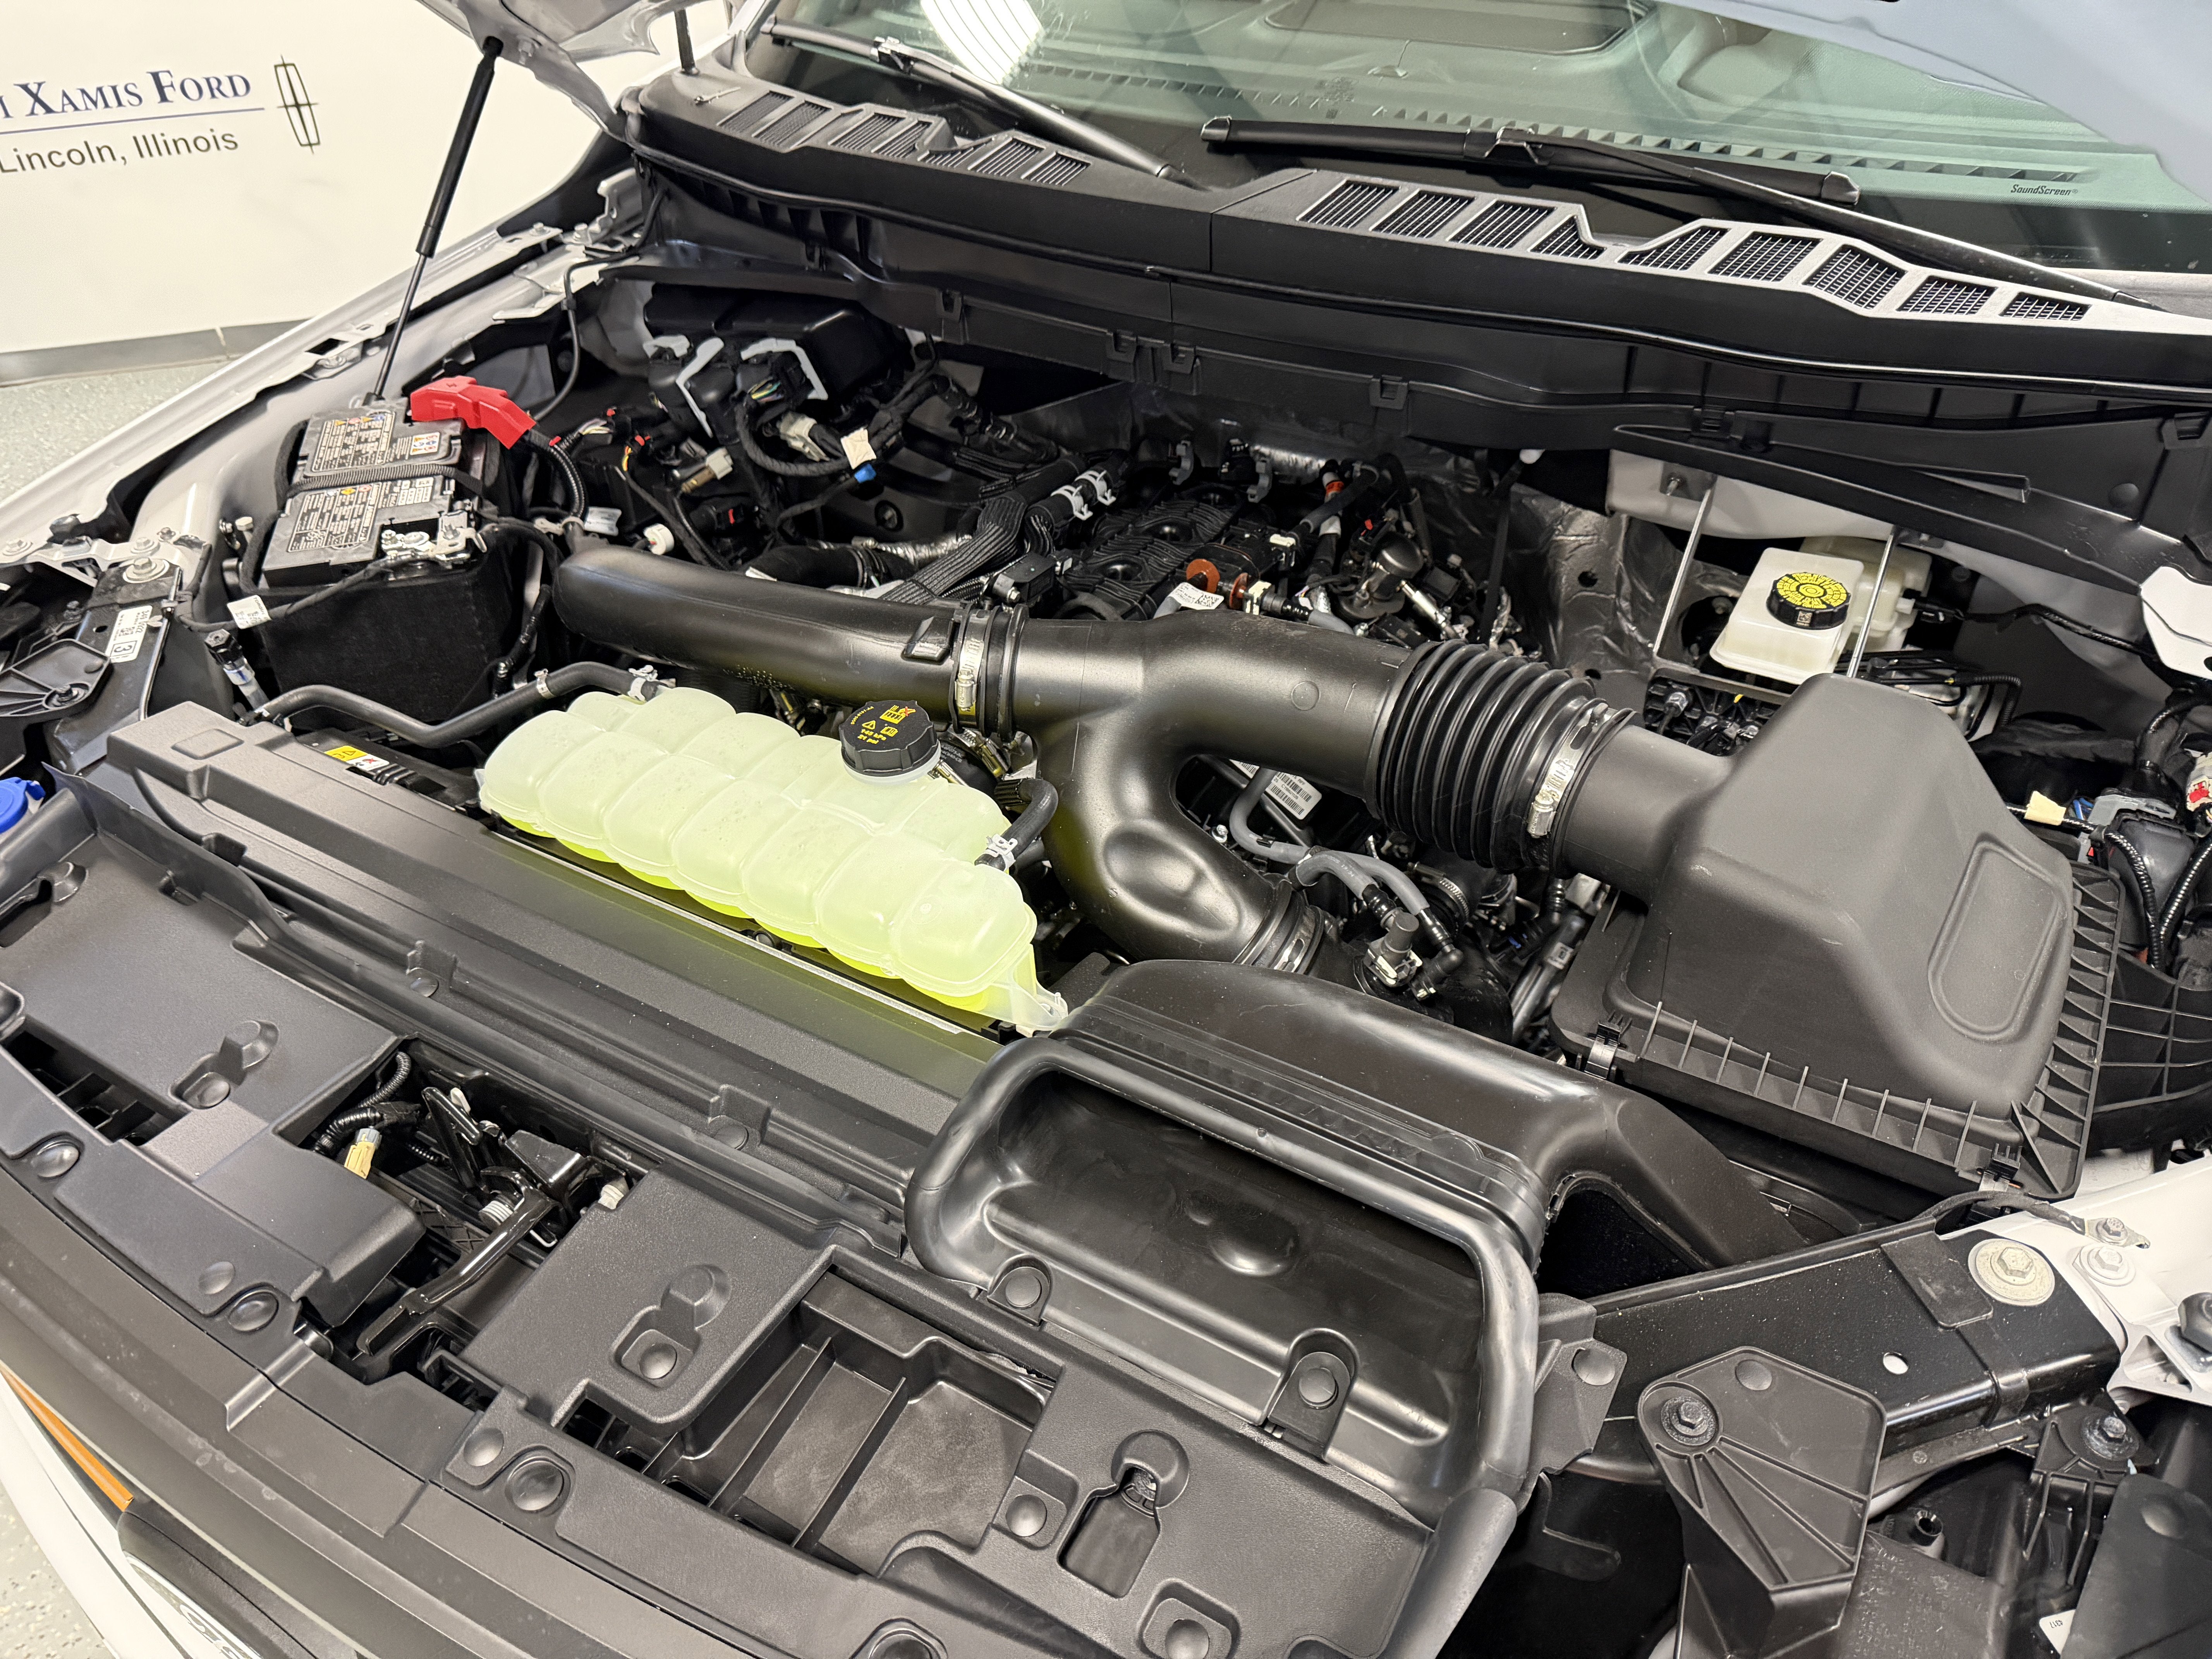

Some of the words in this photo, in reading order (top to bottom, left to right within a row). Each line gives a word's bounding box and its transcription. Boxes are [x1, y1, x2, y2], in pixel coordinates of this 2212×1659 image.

[13, 81, 143, 117] XAMIS
[146, 69, 251, 104] FORD
[132, 128, 239, 159] Illinois
